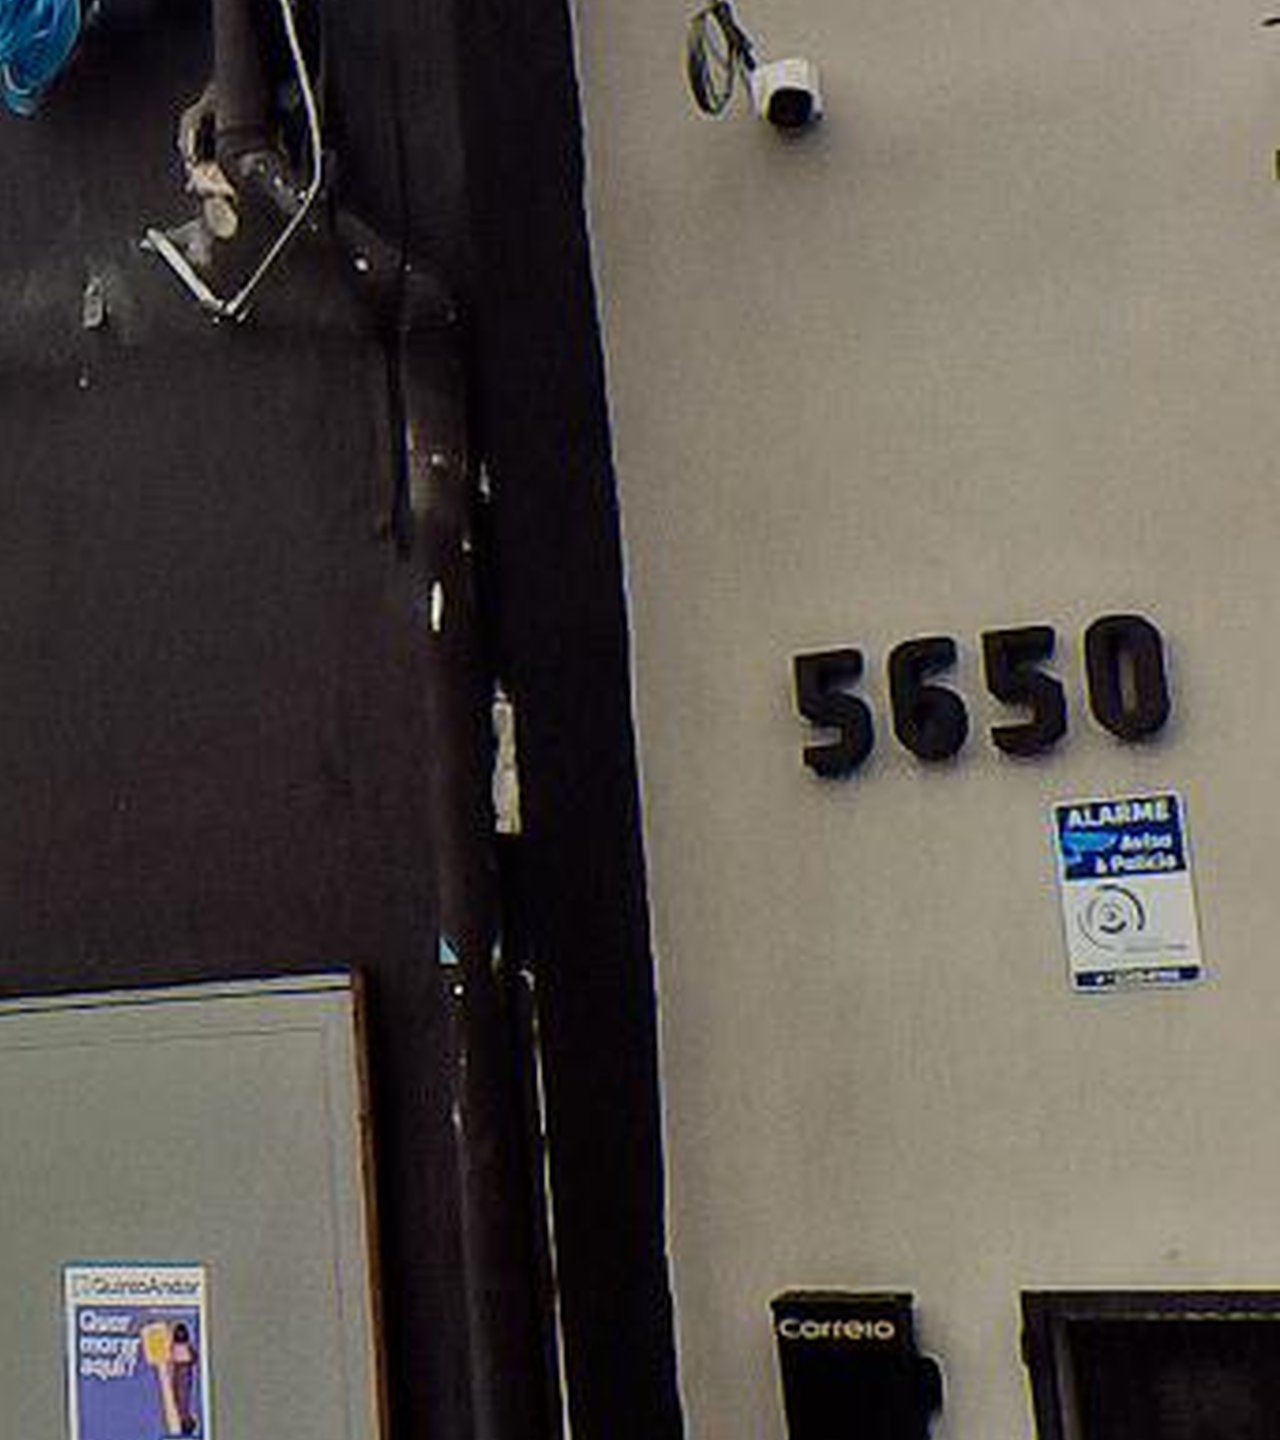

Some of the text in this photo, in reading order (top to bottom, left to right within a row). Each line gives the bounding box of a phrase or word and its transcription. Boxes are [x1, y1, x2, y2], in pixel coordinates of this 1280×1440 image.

[793, 614, 1173, 778] 5650
[1068, 798, 1171, 828] ALARME
[94, 1275, 200, 1295] QuintoAndar
[80, 1310, 133, 1332] Quer
[779, 1318, 895, 1340] Correio
[80, 1337, 141, 1357] morar
